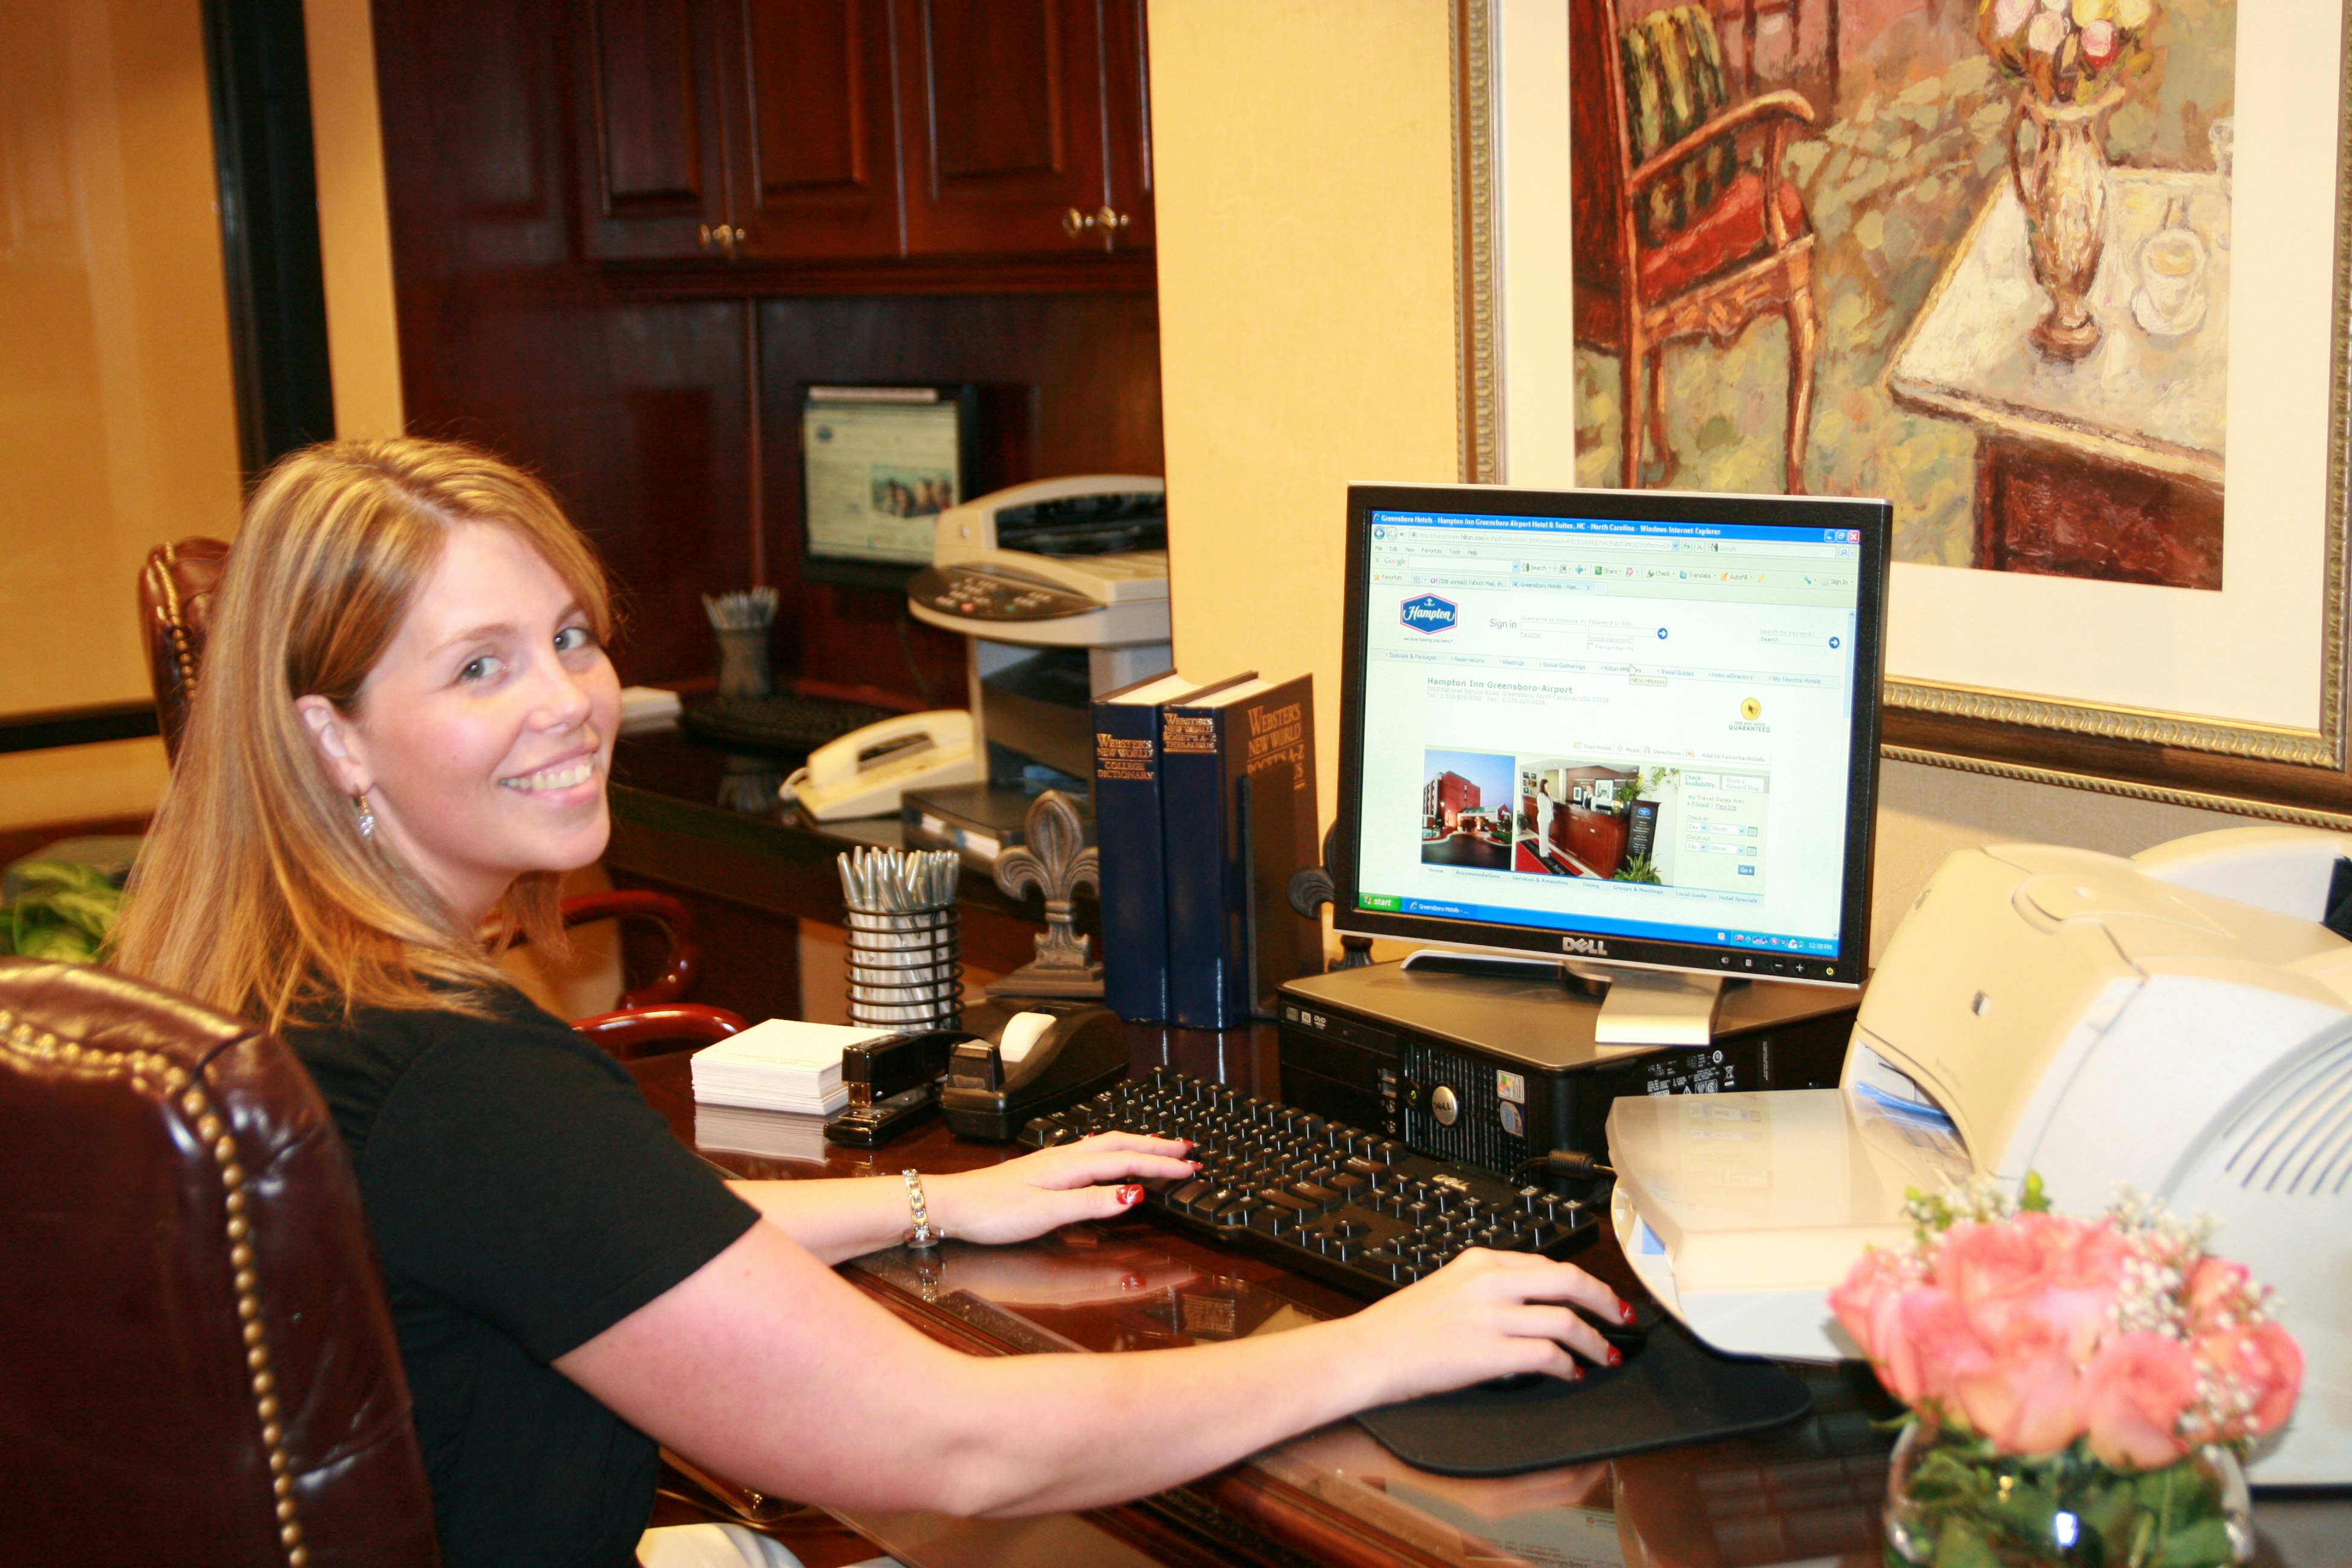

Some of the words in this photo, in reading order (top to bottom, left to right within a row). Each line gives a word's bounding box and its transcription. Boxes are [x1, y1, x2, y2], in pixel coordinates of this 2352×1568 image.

[1384, 557, 1406, 566] Google
[1403, 606, 1455, 621] Hampton
[1489, 619, 1507, 630] Sign
[1509, 619, 1517, 629] in
[1427, 678, 1466, 687] Hampton
[1486, 681, 1573, 694] Greensboro-Airport
[1163, 713, 1213, 726] WEBSTER'S
[1247, 702, 1301, 736] WEBSTER'S
[1728, 724, 1771, 733] GUARANTEED
[1096, 733, 1153, 749] WEBSTER'S
[1163, 733, 1200, 742] ROGET'S
[1248, 737, 1269, 757] NEW
[1270, 722, 1302, 750] WORLD
[1165, 740, 1215, 749] THESAURUS
[1097, 748, 1118, 757] NEW
[1119, 748, 1154, 757] WORLD
[1289, 743, 1304, 760] A-Z
[1653, 748, 1681, 757] Directions
[1104, 761, 1145, 771] COLLEGE
[1097, 769, 1154, 780] DICTIONARY
[1685, 780, 1715, 789] Availability
[1715, 803, 1737, 811] Flexible
[1562, 936, 1608, 956] DELL
[1313, 1014, 1327, 1023] DVD
[1433, 1102, 1451, 1111] DELL
